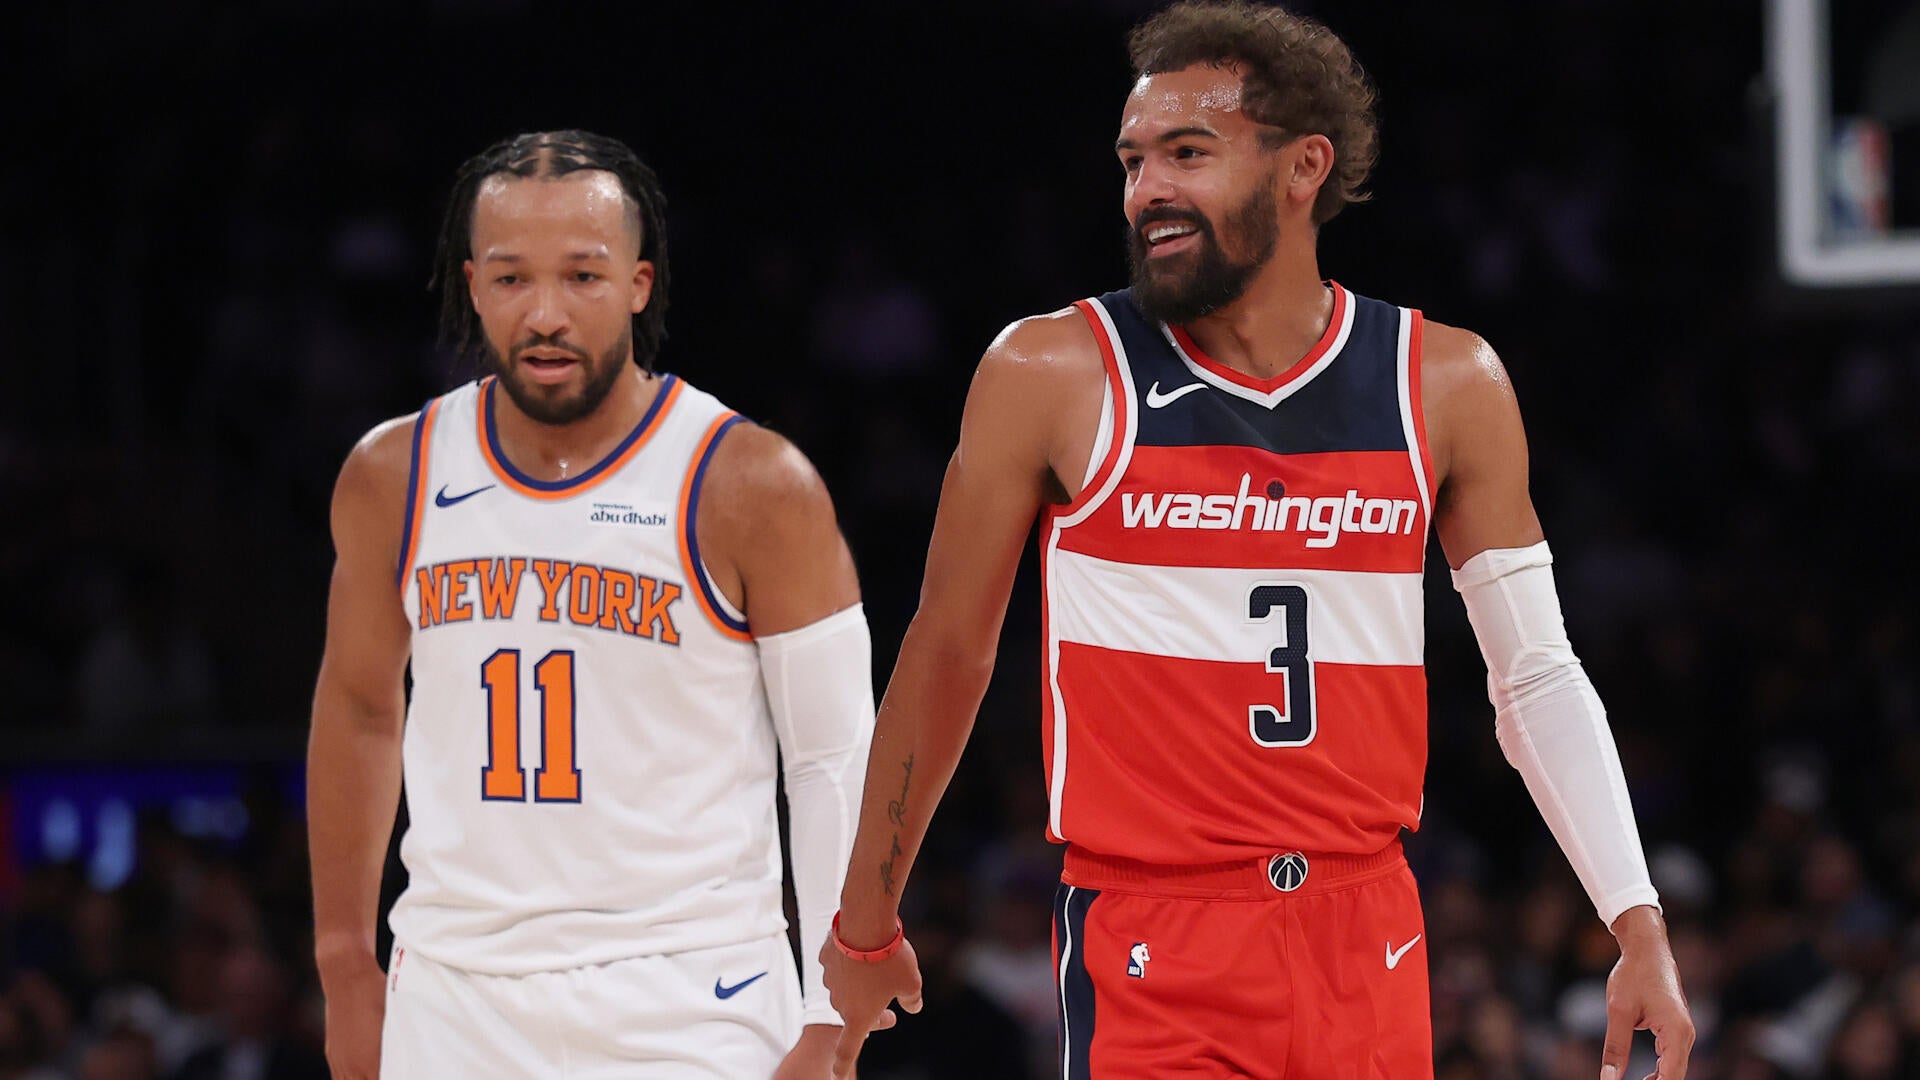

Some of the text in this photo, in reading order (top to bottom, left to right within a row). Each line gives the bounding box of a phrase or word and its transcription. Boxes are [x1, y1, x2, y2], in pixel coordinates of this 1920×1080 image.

[590, 510, 667, 526] abu dhabi
[1121, 472, 1419, 548] washington
[415, 556, 683, 647] NEW YORK
[1247, 582, 1317, 747] 3
[481, 648, 582, 804] 11
